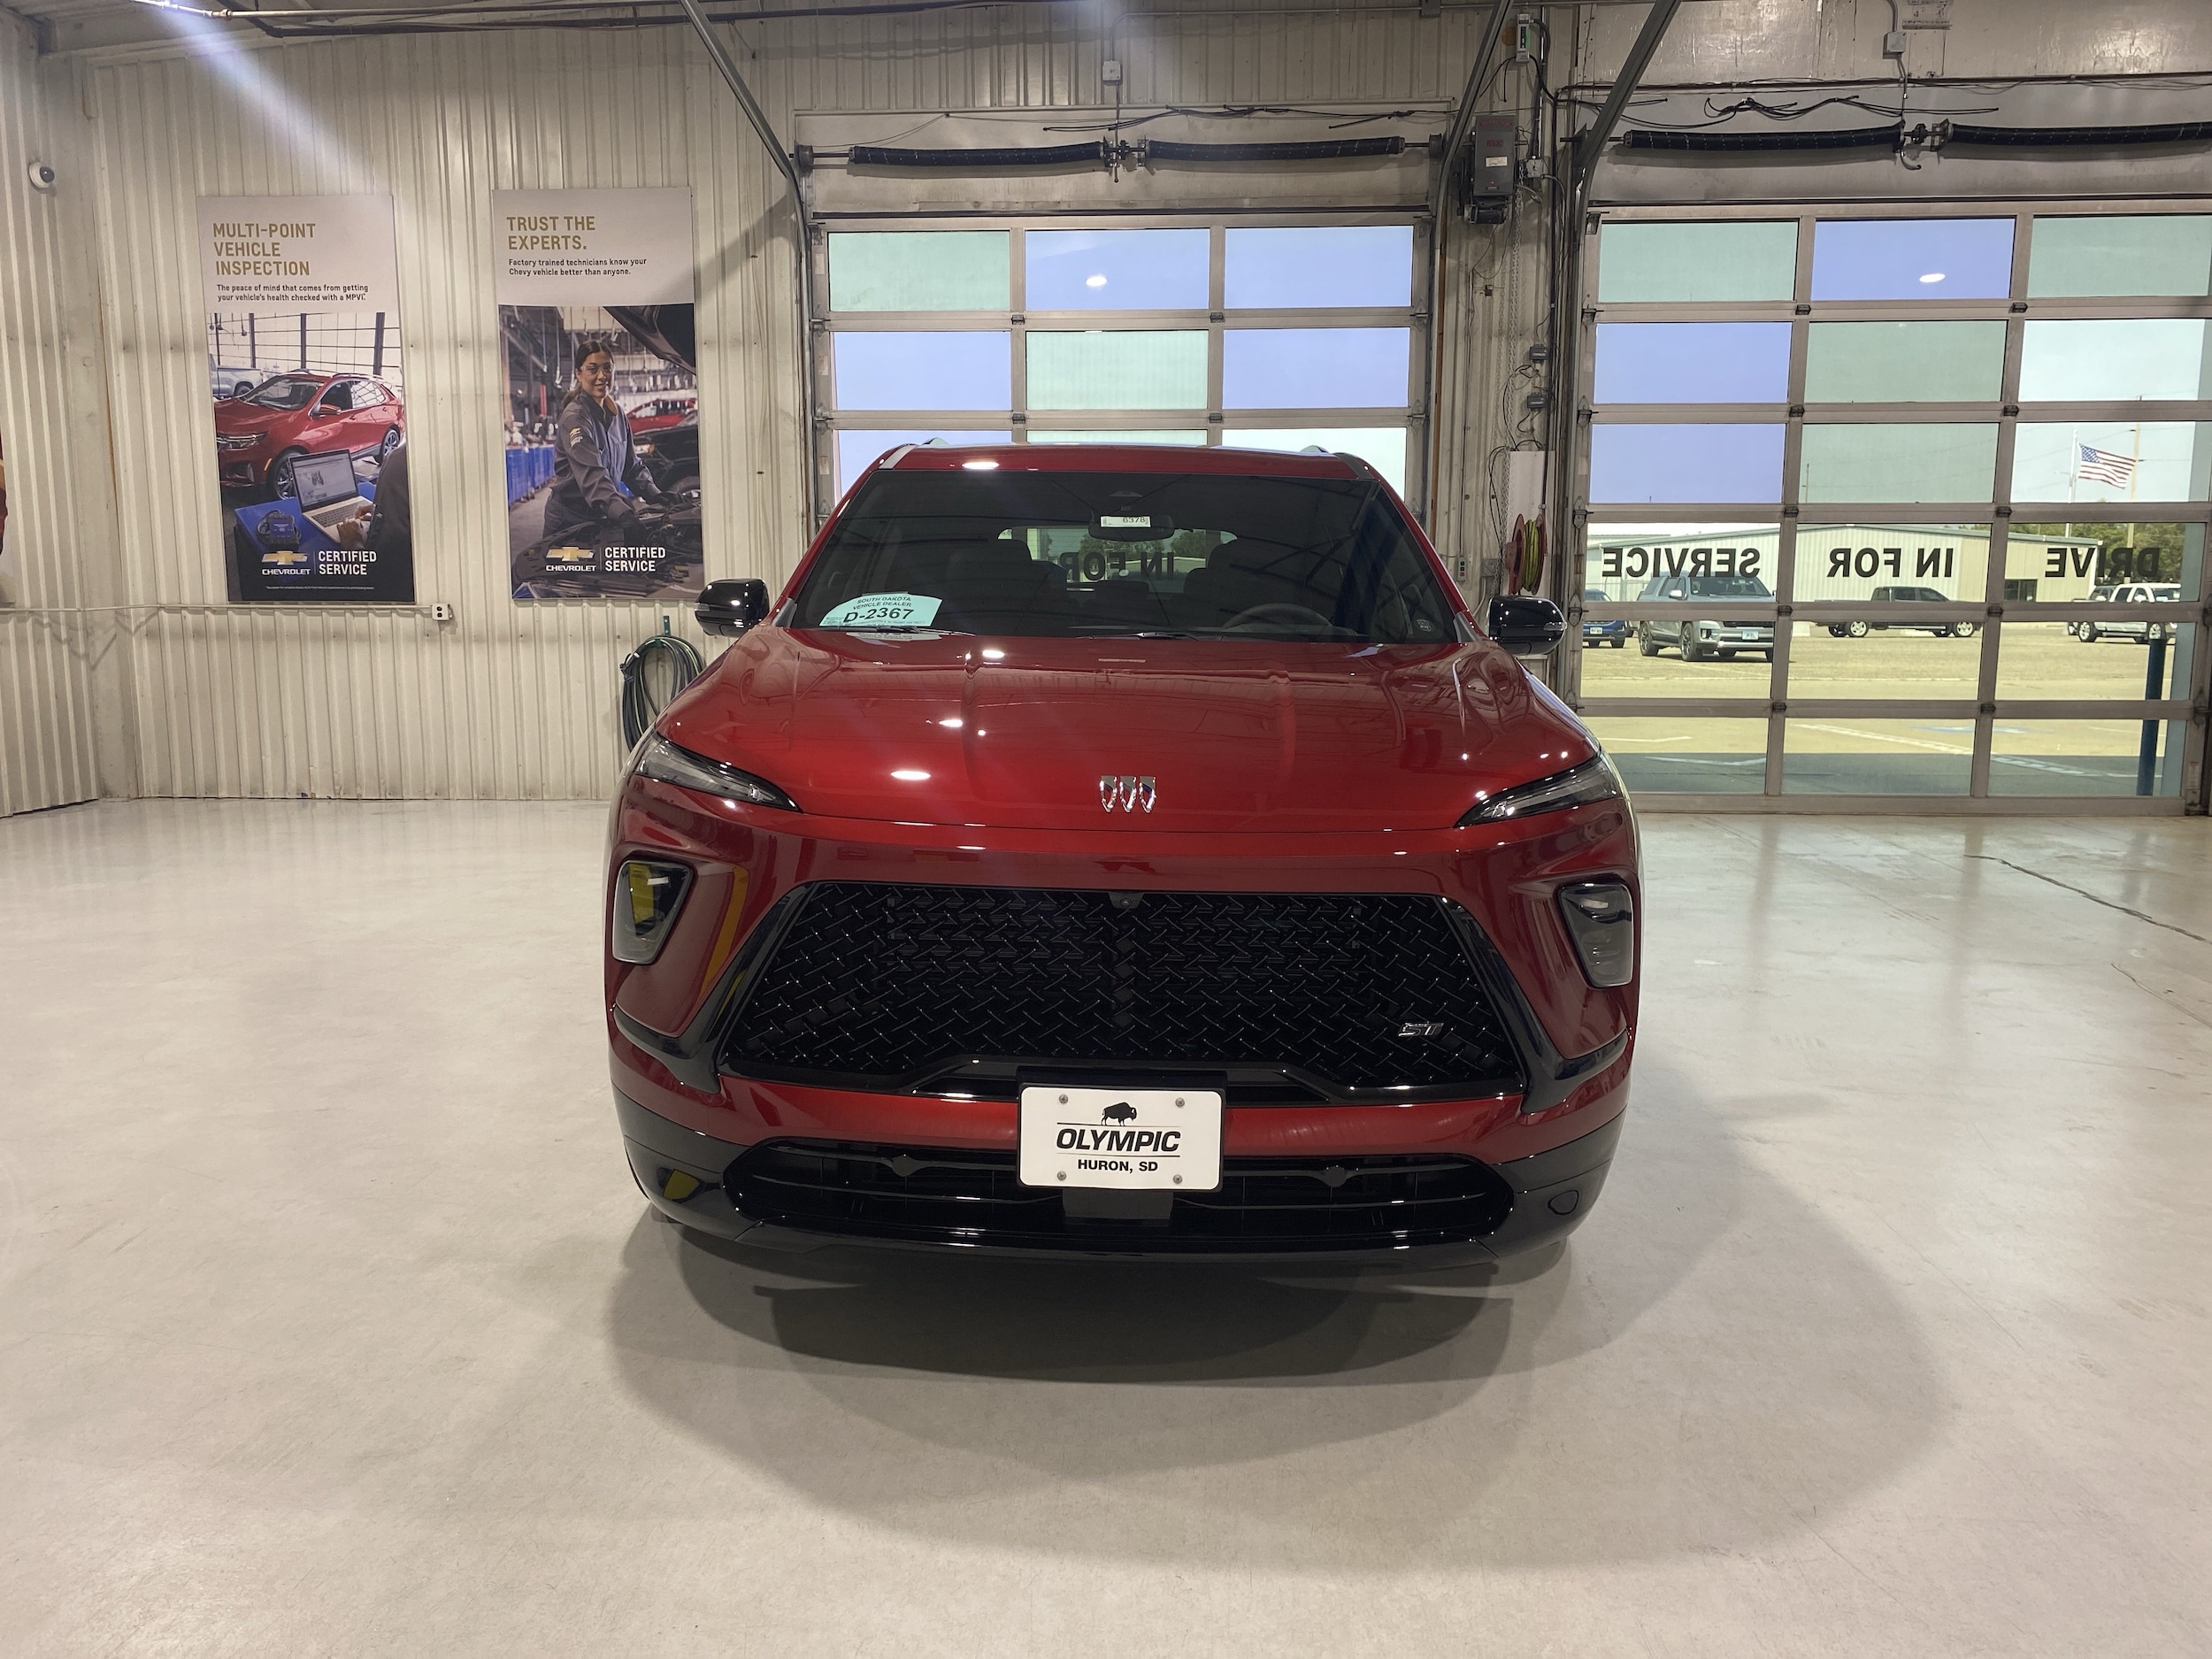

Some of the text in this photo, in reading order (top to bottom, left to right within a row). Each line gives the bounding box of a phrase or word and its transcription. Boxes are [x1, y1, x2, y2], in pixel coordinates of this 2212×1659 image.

[212, 223, 316, 238] MULTI-POINT
[506, 215, 595, 232] TRUST THE
[508, 234, 588, 250] EXPERTS.
[213, 242, 280, 257] VEHICLE
[216, 261, 310, 275] INSPECTION
[509, 258, 537, 267] Factory
[509, 268, 532, 277] Chevy
[342, 284, 369, 293] getting
[319, 550, 377, 563] CERTIFIED
[604, 547, 666, 558] CERTIFIED
[319, 564, 367, 575] SERVICE
[604, 560, 656, 572] SERVICE
[843, 607, 914, 623] D-2367
[1398, 1022, 1444, 1037] ST
[1056, 1128, 1181, 1153] OLYMPIC
[1078, 1159, 1158, 1174] HURON, SD
